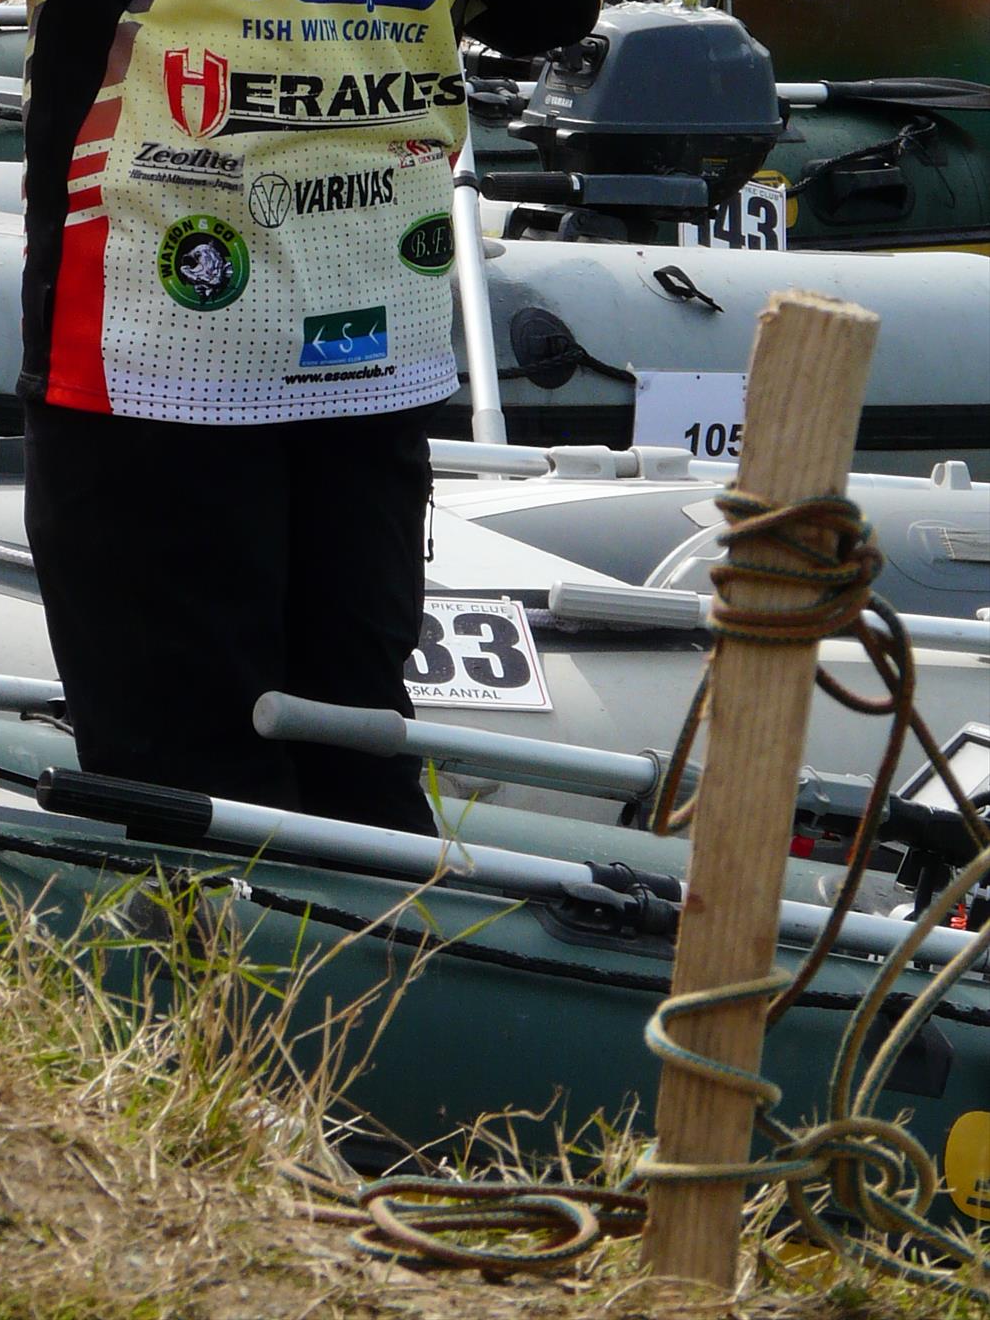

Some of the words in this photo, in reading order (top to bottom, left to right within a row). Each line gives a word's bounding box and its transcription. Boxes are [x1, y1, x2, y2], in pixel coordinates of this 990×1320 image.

[241, 18, 292, 41] FISH
[164, 47, 466, 139] HERAKLES
[294, 167, 395, 216] VARIVAS
[160, 219, 195, 279] WATSON
[213, 222, 235, 242] CO
[284, 363, 396, 385] www.esoxclub.ro
[431, 602, 466, 613] PIKE
[449, 688, 502, 700] ANTAL
